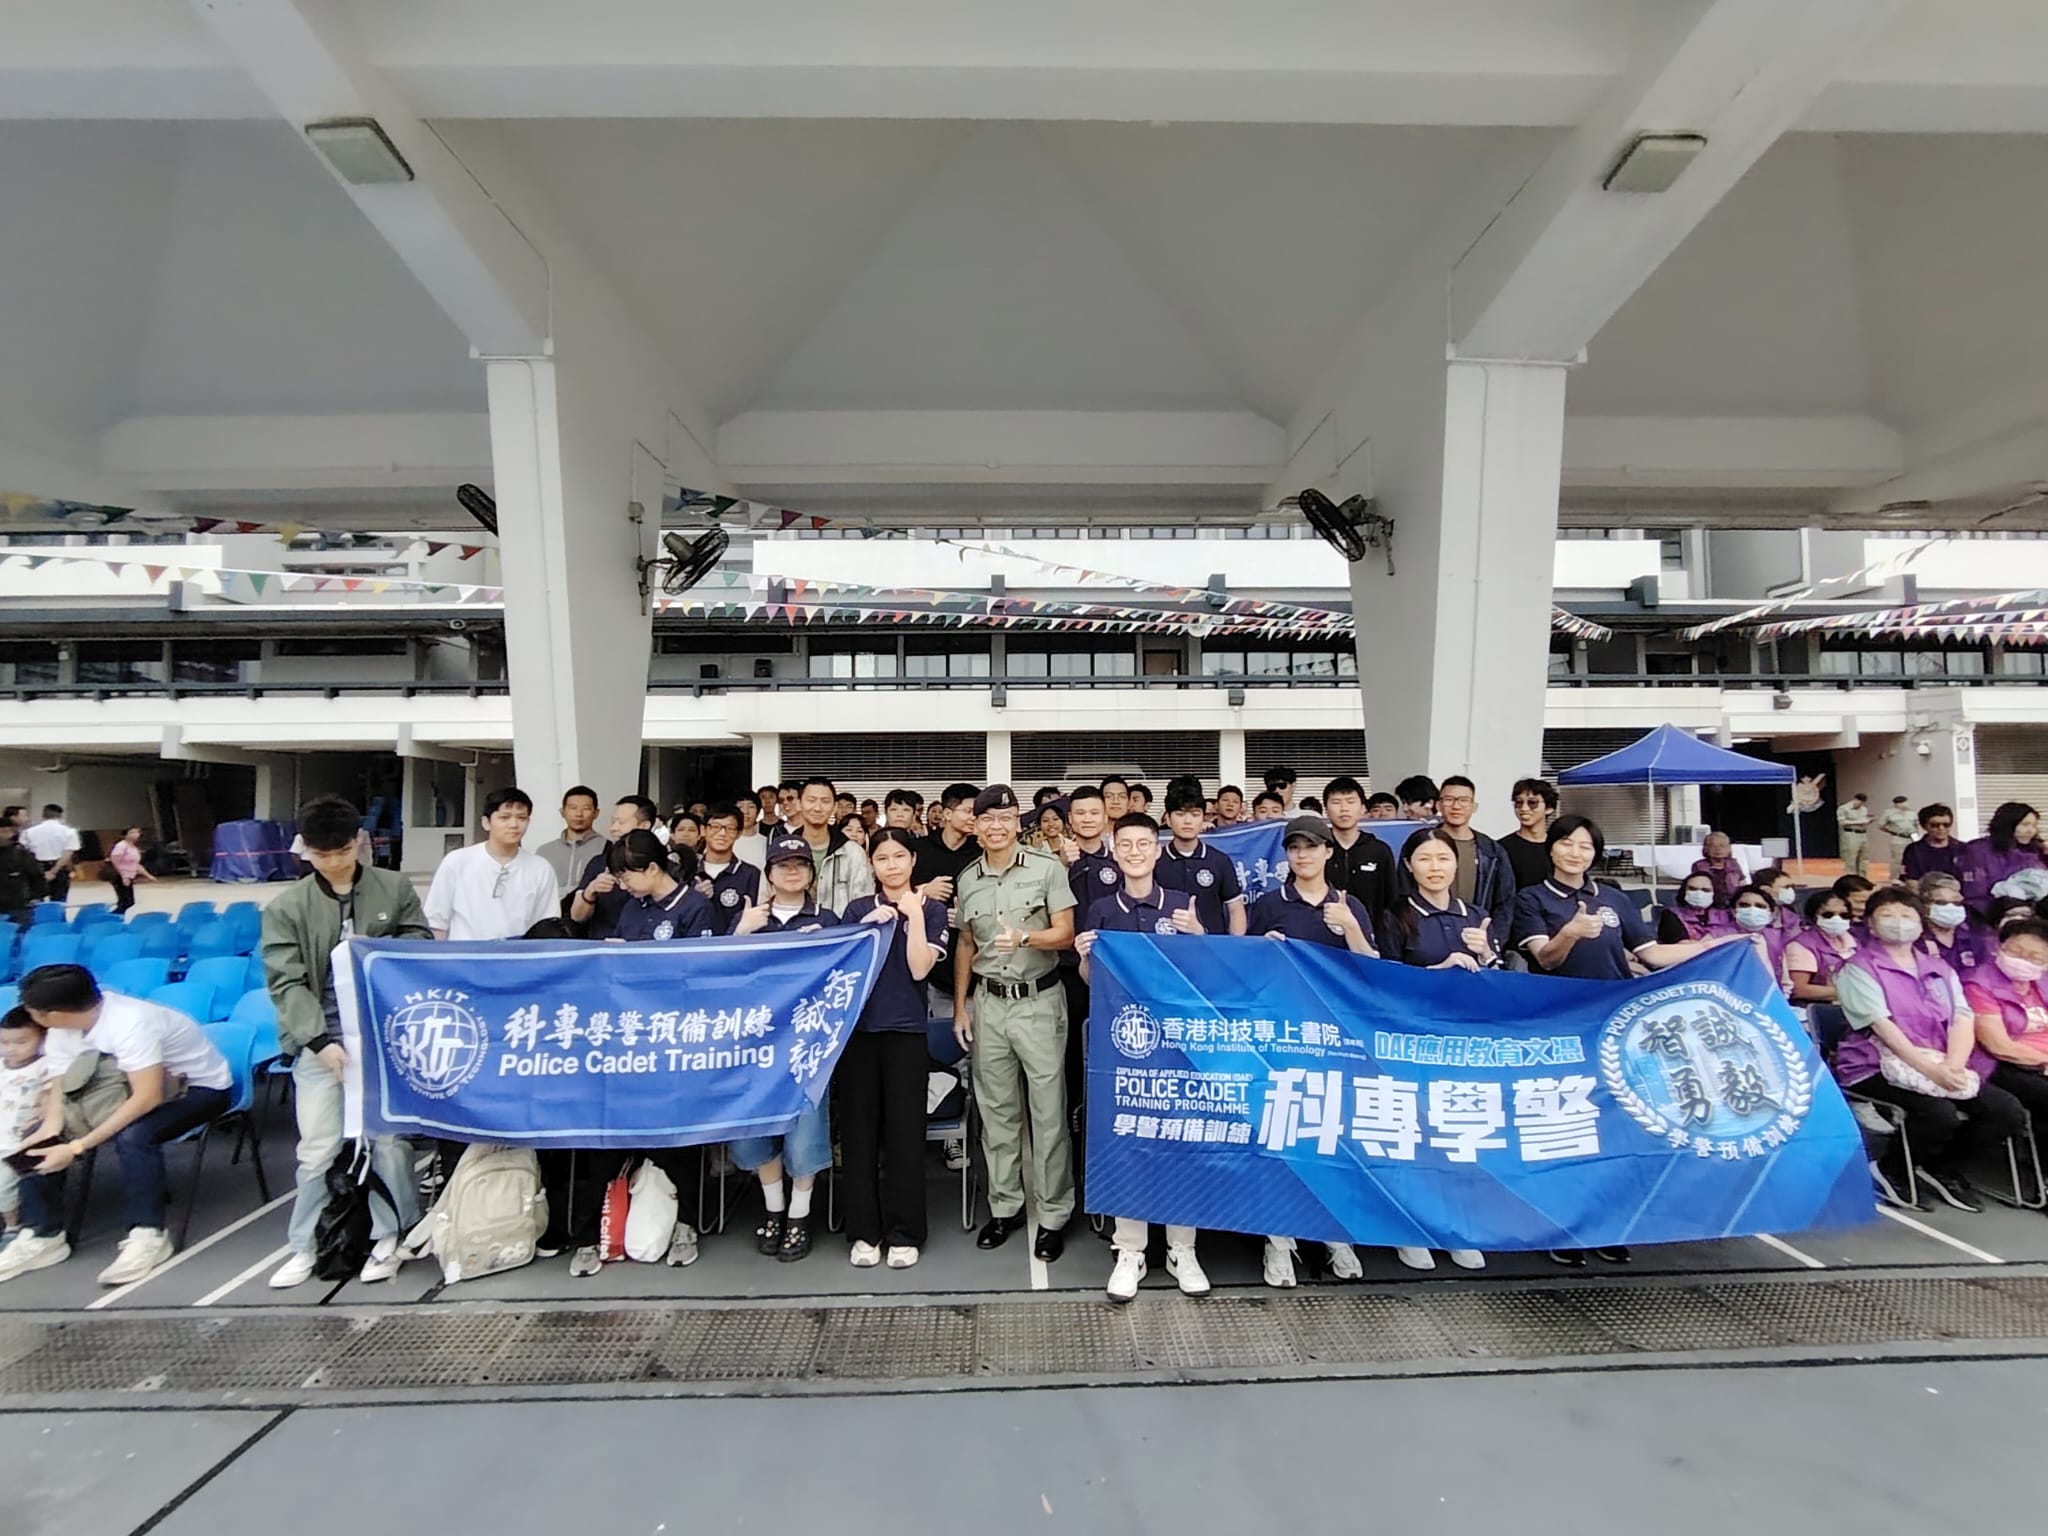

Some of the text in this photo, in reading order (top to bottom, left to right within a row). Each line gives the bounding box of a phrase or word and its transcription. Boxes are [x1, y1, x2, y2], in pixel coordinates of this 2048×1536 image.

[404, 989, 470, 1004] HKIT
[1122, 1004, 1151, 1012] HKIT
[1606, 983, 1753, 1036] POLICE CADET TRAINING
[503, 1003, 776, 1051] 科專學警預備訓練
[1162, 1017, 1341, 1047] 香港科技專上書院
[498, 1044, 775, 1076] Police Cadet Training
[1162, 1040, 1187, 1052] Hong
[1190, 1042, 1214, 1053] Kong
[1218, 1042, 1256, 1052] Institute
[1259, 1043, 1268, 1052] of
[1270, 1043, 1325, 1057] Technology
[1116, 1066, 1148, 1077] DIPLOMA
[1149, 1069, 1159, 1078] OF
[1160, 1069, 1189, 1079] APPLIED
[1191, 1071, 1231, 1081] EDUCATION
[1115, 1076, 1249, 1102] POLICE CADET
[1115, 1095, 1250, 1115] TRAINING PROGRAMME
[1257, 1068, 1601, 1163] 科專學警
[1113, 1113, 1252, 1144] 學警預備訓練
[600, 1215, 610, 1260] Coffee
